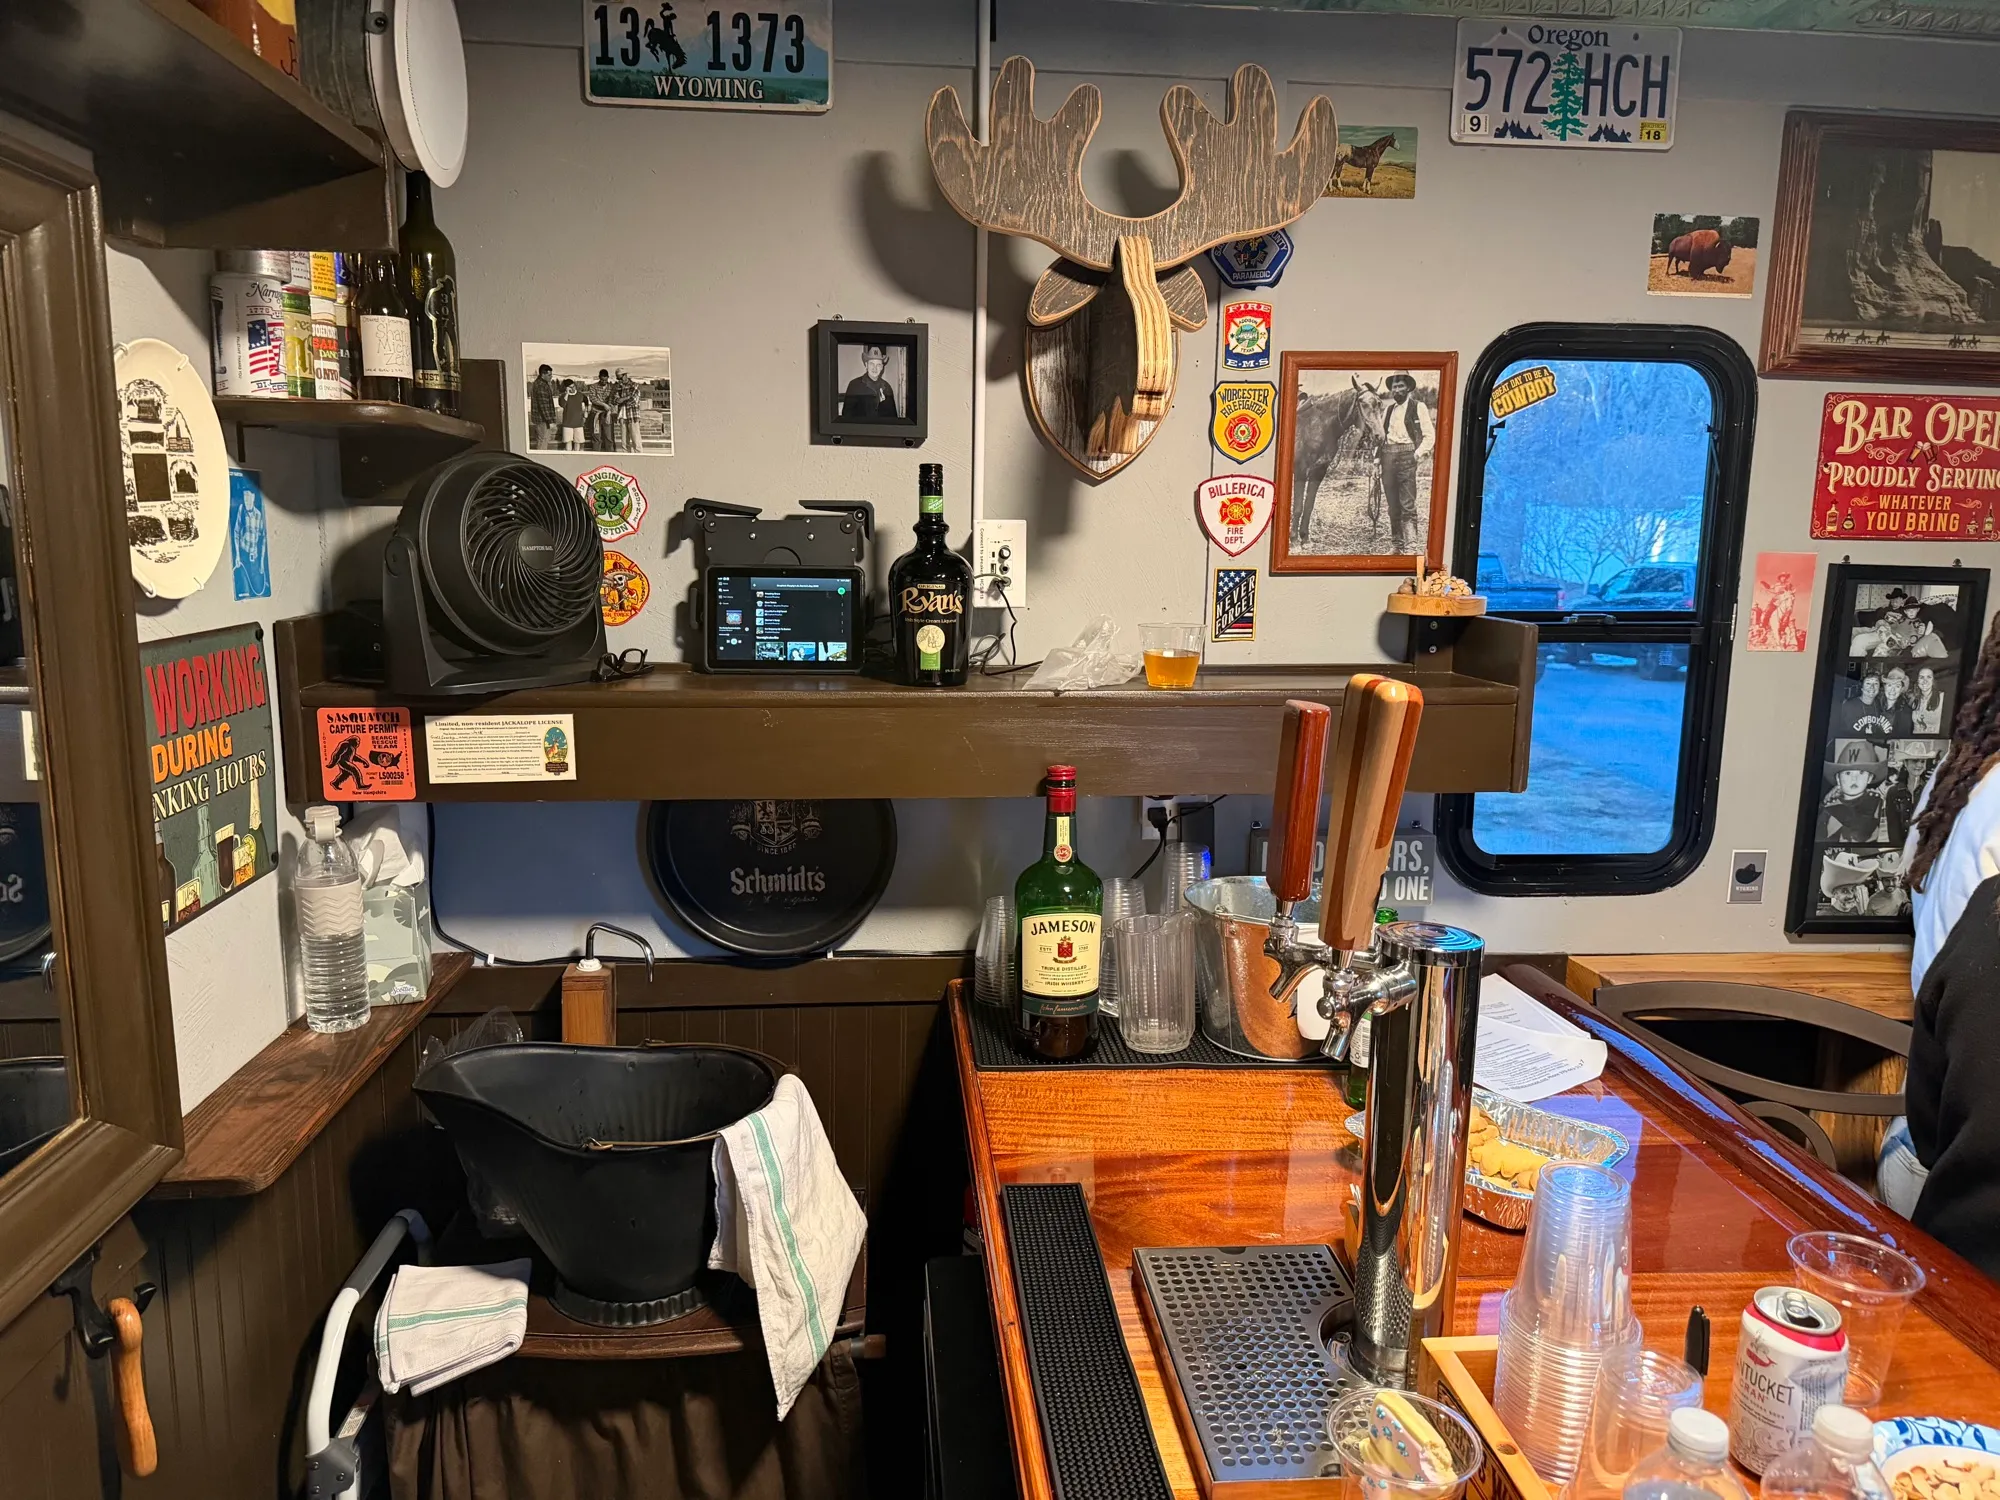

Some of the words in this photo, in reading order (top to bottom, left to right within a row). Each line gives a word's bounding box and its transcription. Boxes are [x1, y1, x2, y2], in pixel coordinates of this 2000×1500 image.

[594, 5, 640, 67] 13
[707, 10, 804, 73] 1373
[1528, 25, 1610, 51] Oregon
[653, 76, 763, 99] WYOMING
[1465, 47, 1551, 114] 572
[1582, 53, 1670, 118] HCH
[1470, 116, 1481, 131] 9
[1646, 131, 1660, 140] 18
[1270, 231, 1287, 250] UNTY
[1233, 271, 1270, 280] PARAMEDIC
[1229, 304, 1271, 314] FIRE
[418, 372, 439, 381] JUST
[1492, 383, 1510, 399] GREAT
[1510, 376, 1523, 388] DAY
[1523, 372, 1532, 382] TO
[1534, 370, 1542, 378] BE
[1218, 388, 1269, 407] WORCESTER
[1492, 376, 1555, 417] COWBOY
[1220, 401, 1266, 418] FIREFIGHTER
[589, 472, 625, 484] ENGINE
[1208, 482, 1266, 499] BILLERICA
[596, 494, 619, 509] 39
[1878, 495, 1952, 510] WHATEVER
[598, 524, 629, 536] OSTON
[1866, 511, 1902, 531] YOU
[1904, 512, 1960, 532] BRING
[898, 587, 963, 615] Ryan's
[1216, 574, 1255, 617] NEVER
[1216, 592, 1254, 636] FORGET
[144, 644, 266, 738] WORKING
[327, 712, 400, 723] SASQUATCH
[330, 724, 366, 734] CAPTURE
[369, 724, 398, 733] PERMIT
[151, 722, 233, 784] DURING
[1849, 748, 1860, 763] W
[152, 775, 209, 823] NKING
[216, 750, 266, 796] HOURS
[757, 846, 778, 855] SINCE
[730, 865, 825, 895] Schmidt's
[1394, 876, 1428, 901] ONE
[1031, 920, 1096, 936] JAMESON
[1739, 1379, 1766, 1403] CRAN
